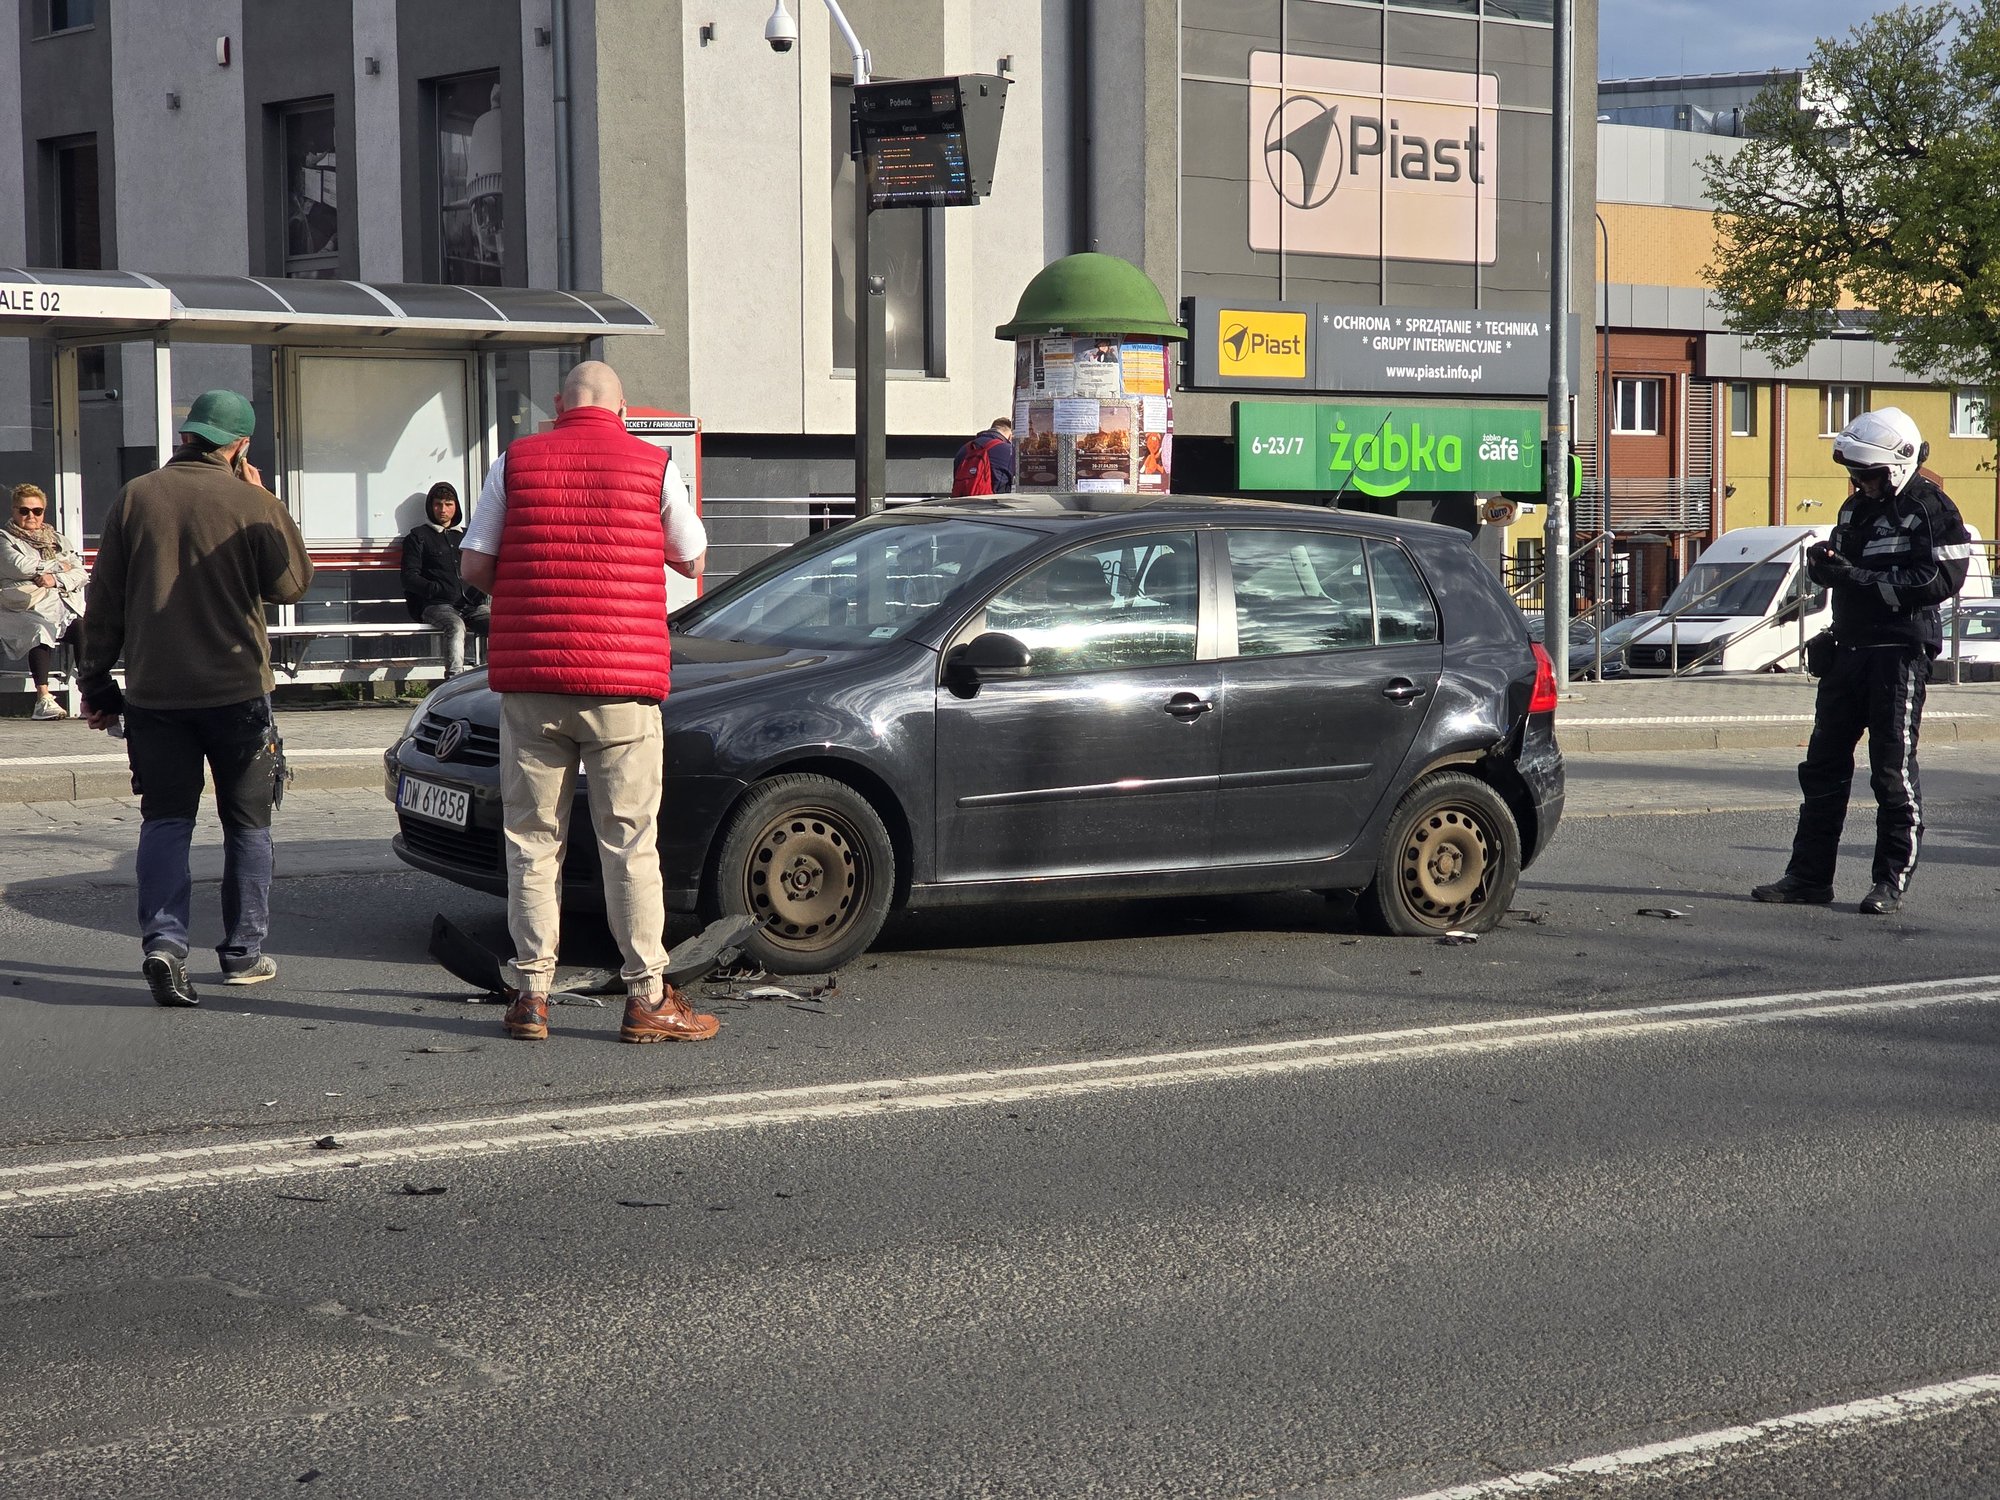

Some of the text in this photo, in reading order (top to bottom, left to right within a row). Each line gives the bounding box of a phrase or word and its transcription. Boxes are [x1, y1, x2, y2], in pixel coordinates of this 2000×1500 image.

[1349, 114, 1485, 185] Piast
[0, 289, 61, 312] ALE 02
[1333, 315, 1539, 336] OCHRONA SPRZĄTANIE TECHNIKA
[1251, 333, 1301, 355] Piast
[1372, 336, 1502, 354] GRUPY INTERWENCYJNE
[1386, 364, 1482, 382] www.piast.info.pl
[1251, 436, 1304, 455] 6-23/7
[1329, 419, 1462, 472] żabka
[403, 779, 466, 822] DW 6Y858
